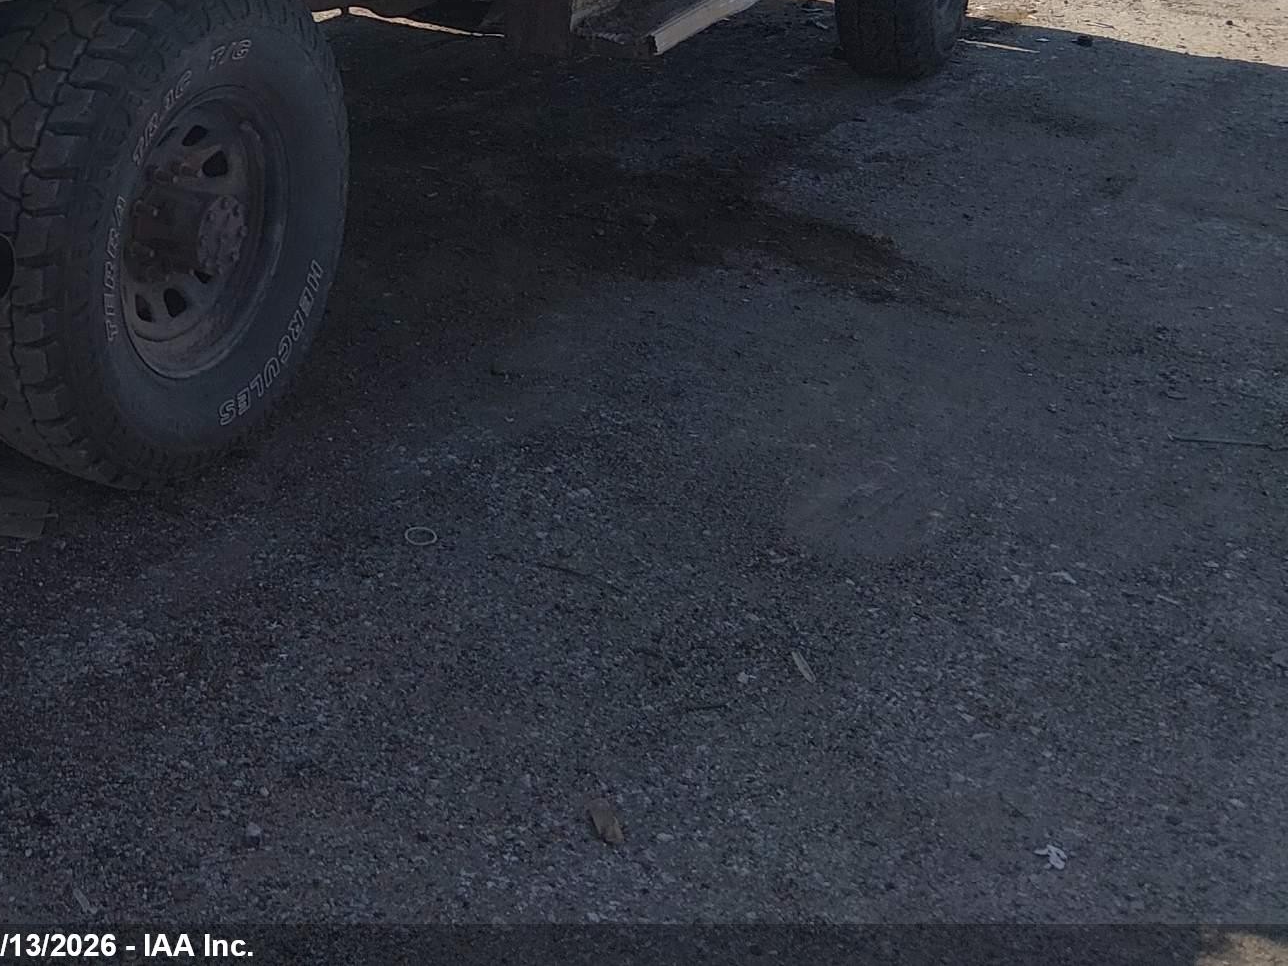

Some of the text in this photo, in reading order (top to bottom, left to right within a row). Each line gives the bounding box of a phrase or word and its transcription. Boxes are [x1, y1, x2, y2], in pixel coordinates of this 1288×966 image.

[103, 194, 126, 342] TERRA
[133, 68, 192, 168] TRAC
[219, 259, 324, 427] HERCULES
